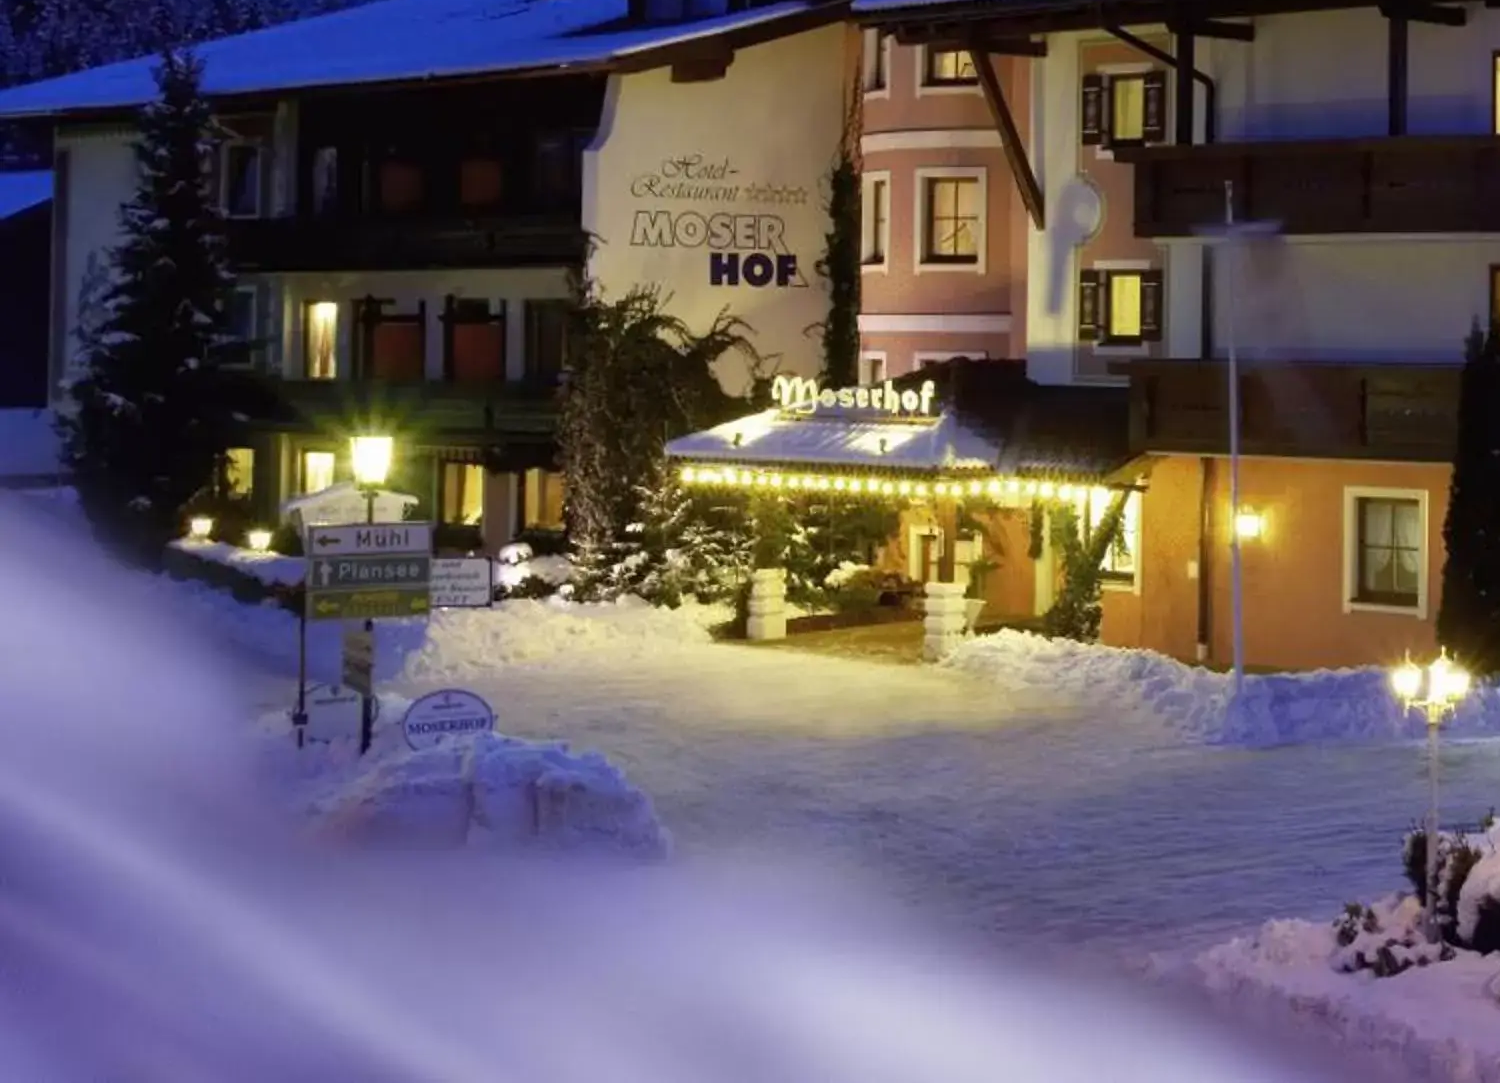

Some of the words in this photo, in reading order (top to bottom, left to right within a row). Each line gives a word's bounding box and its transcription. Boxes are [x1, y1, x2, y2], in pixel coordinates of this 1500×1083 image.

[630, 173, 740, 203] Restaurant
[630, 210, 789, 250] MOSER
[709, 251, 798, 287] HOF
[771, 374, 936, 415] Moserhof
[356, 528, 410, 549] Mühl
[338, 561, 419, 581] Plansee
